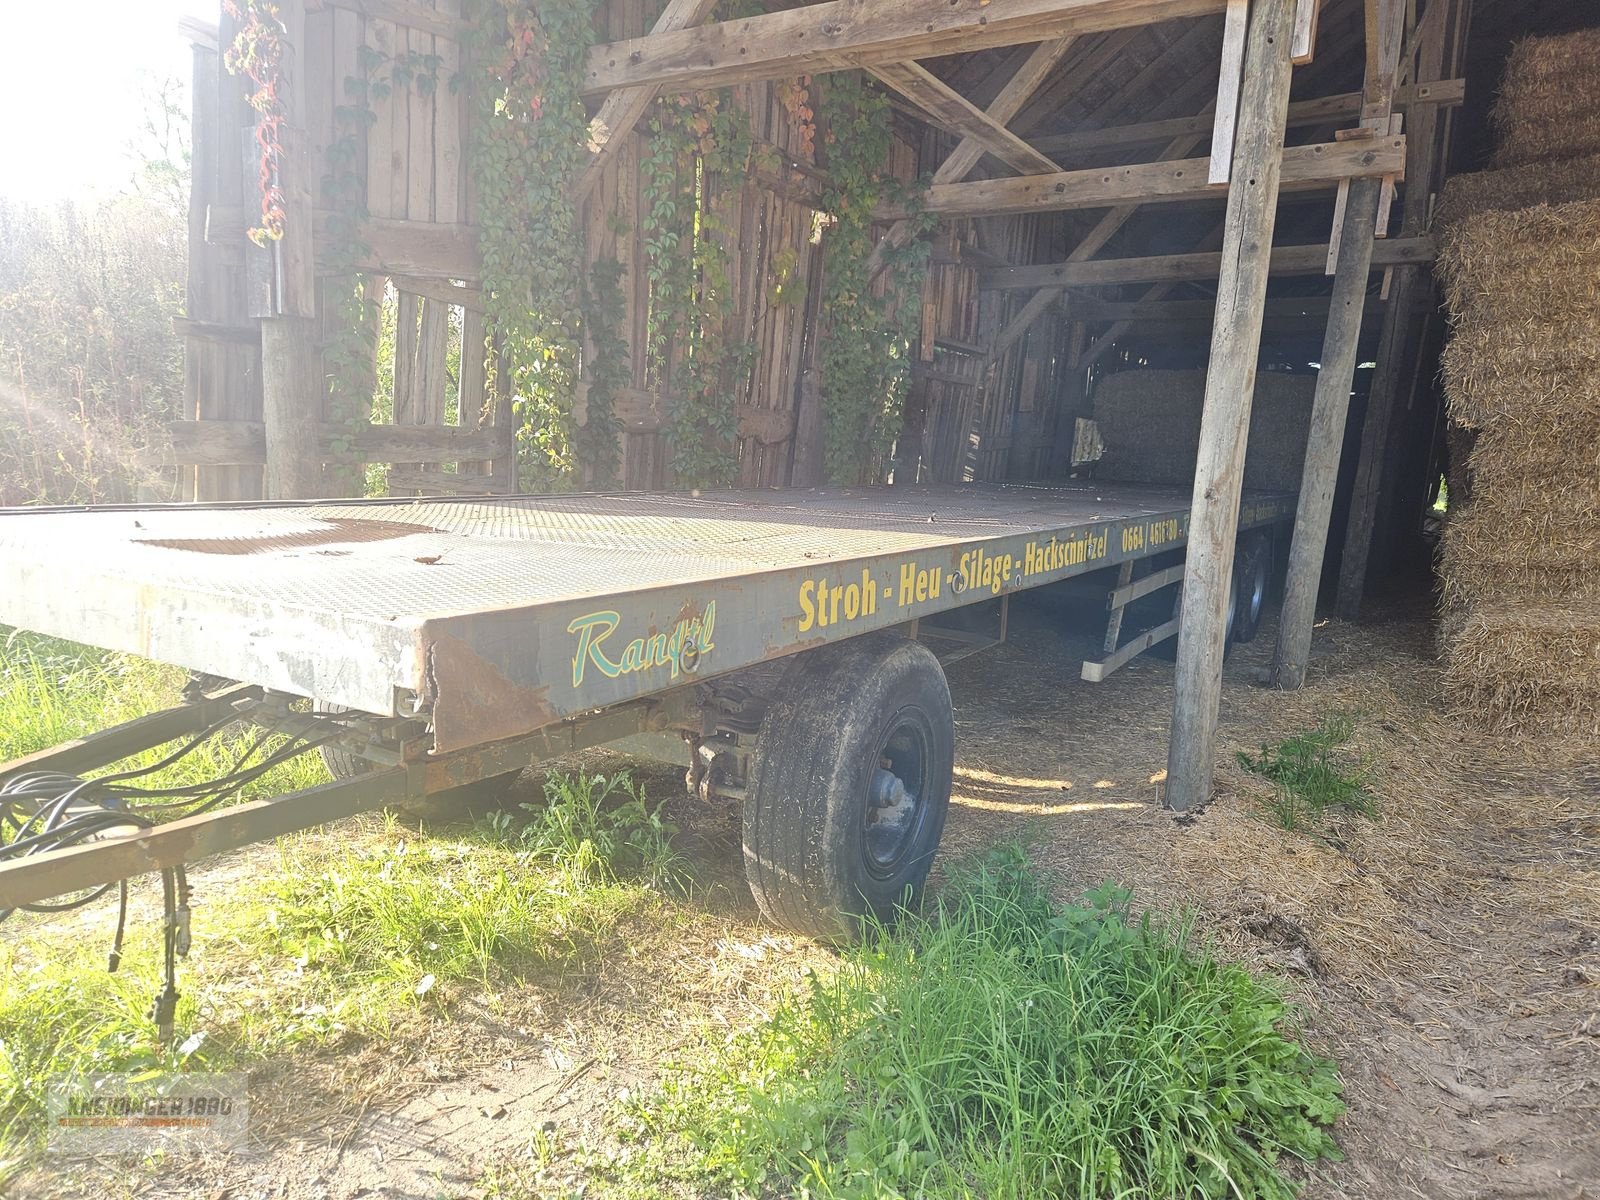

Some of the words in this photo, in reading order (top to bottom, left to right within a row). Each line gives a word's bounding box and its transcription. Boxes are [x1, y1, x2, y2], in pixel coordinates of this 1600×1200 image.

[798, 568, 877, 633] Stroh
[898, 562, 942, 607] Heu
[957, 548, 1011, 594] Silage
